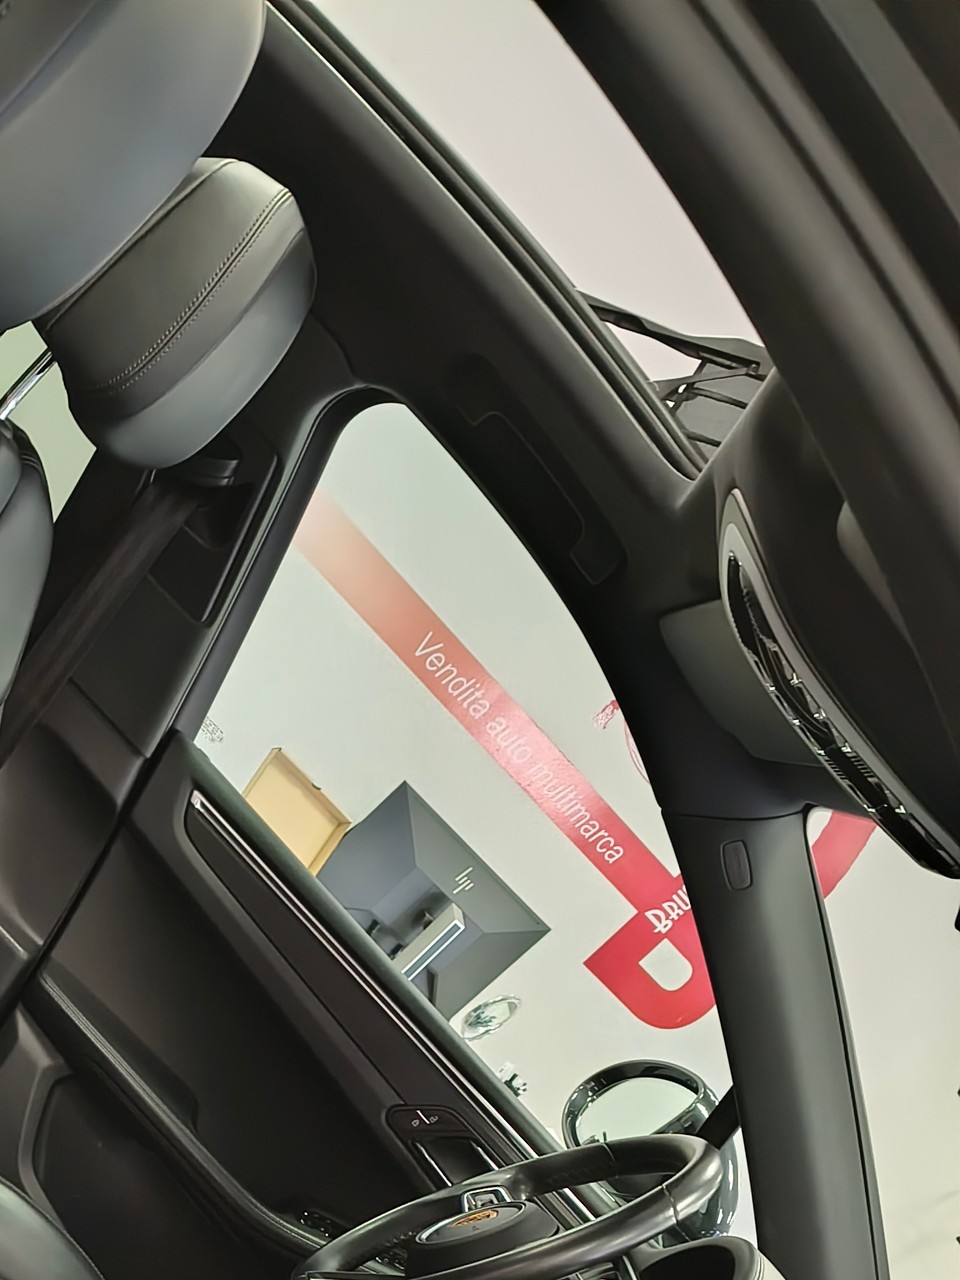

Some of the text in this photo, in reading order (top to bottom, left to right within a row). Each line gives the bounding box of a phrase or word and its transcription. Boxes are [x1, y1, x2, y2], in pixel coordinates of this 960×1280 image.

[414, 631, 624, 864] Vendita auto multimarca
[644, 885, 691, 934] BRU
